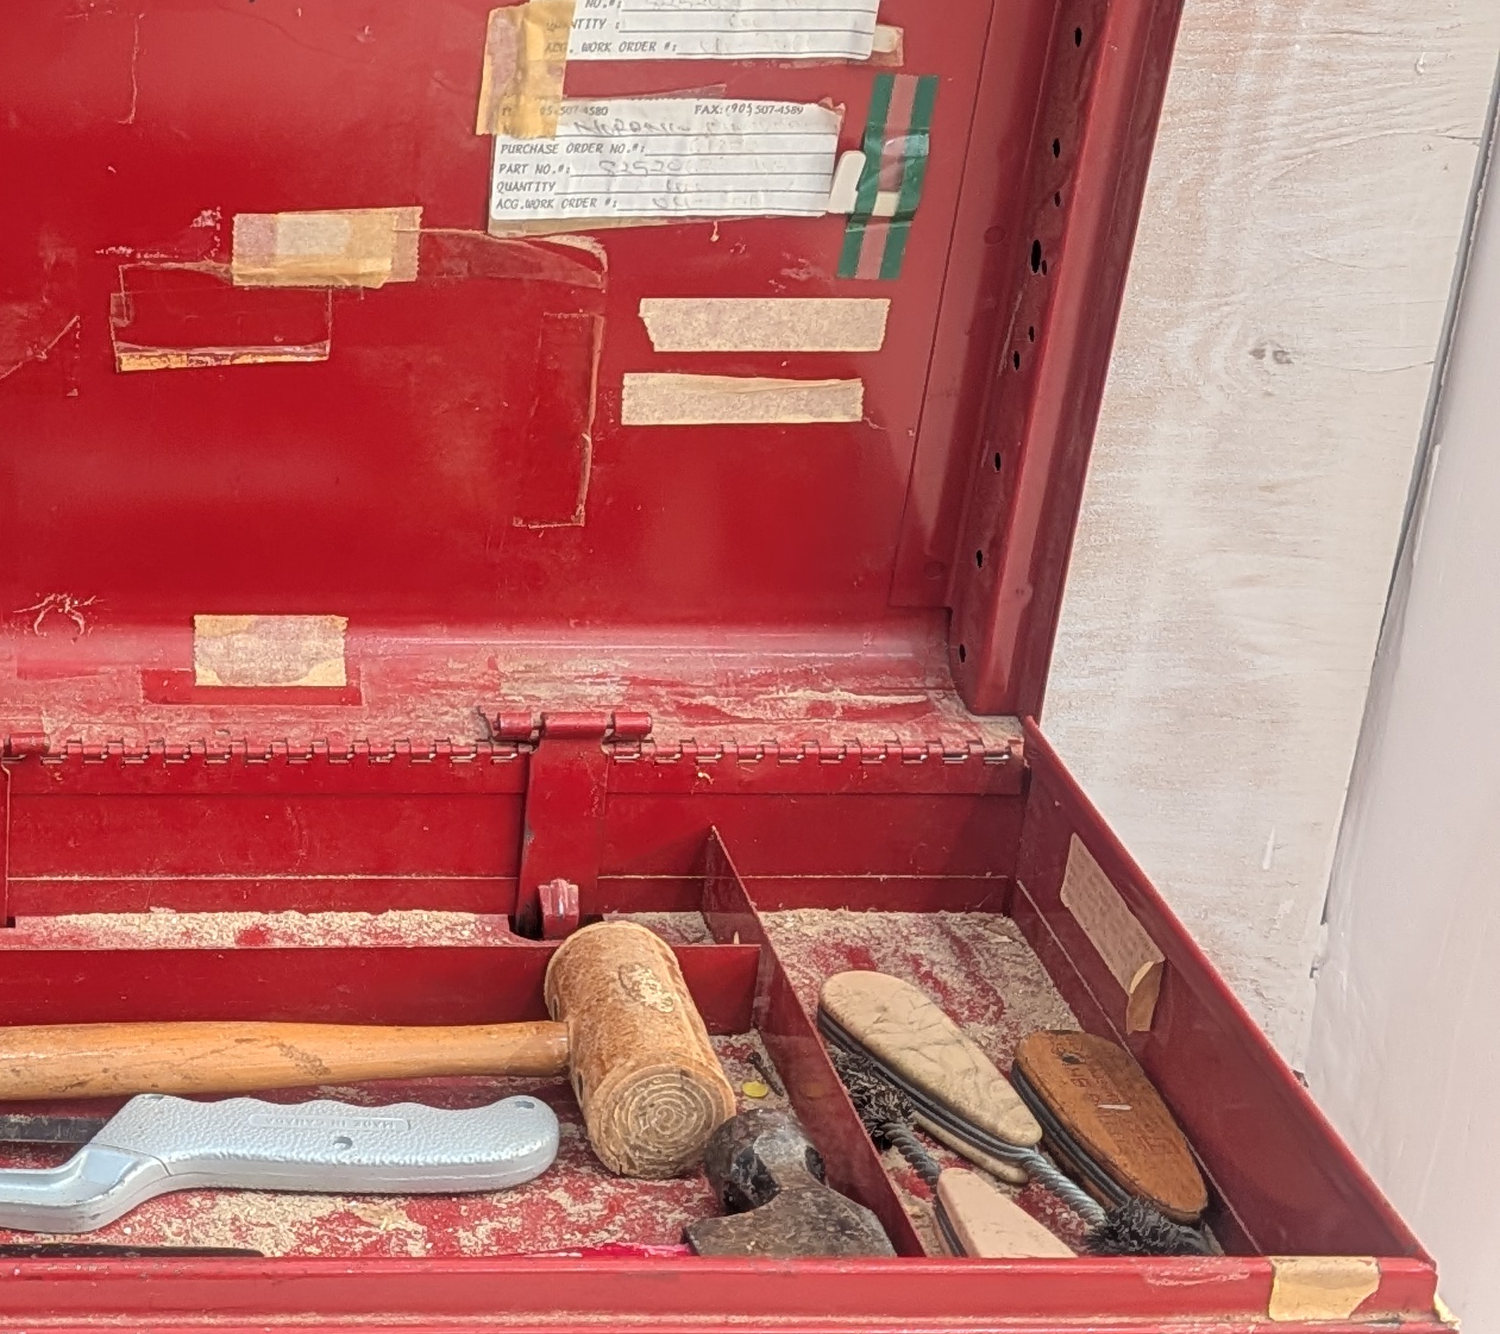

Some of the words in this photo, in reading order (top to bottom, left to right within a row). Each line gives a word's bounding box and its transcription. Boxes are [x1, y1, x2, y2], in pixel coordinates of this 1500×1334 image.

[581, 41, 612, 53] WORK
[618, 41, 658, 53] ORDER
[694, 104, 724, 116] FAX:
[754, 104, 805, 116] 507-4589
[500, 143, 560, 155] PURCHASE
[565, 142, 604, 154] ORDER
[498, 163, 530, 175] PART
[495, 181, 558, 193] QUANTITY
[560, 197, 598, 210] ORDER
